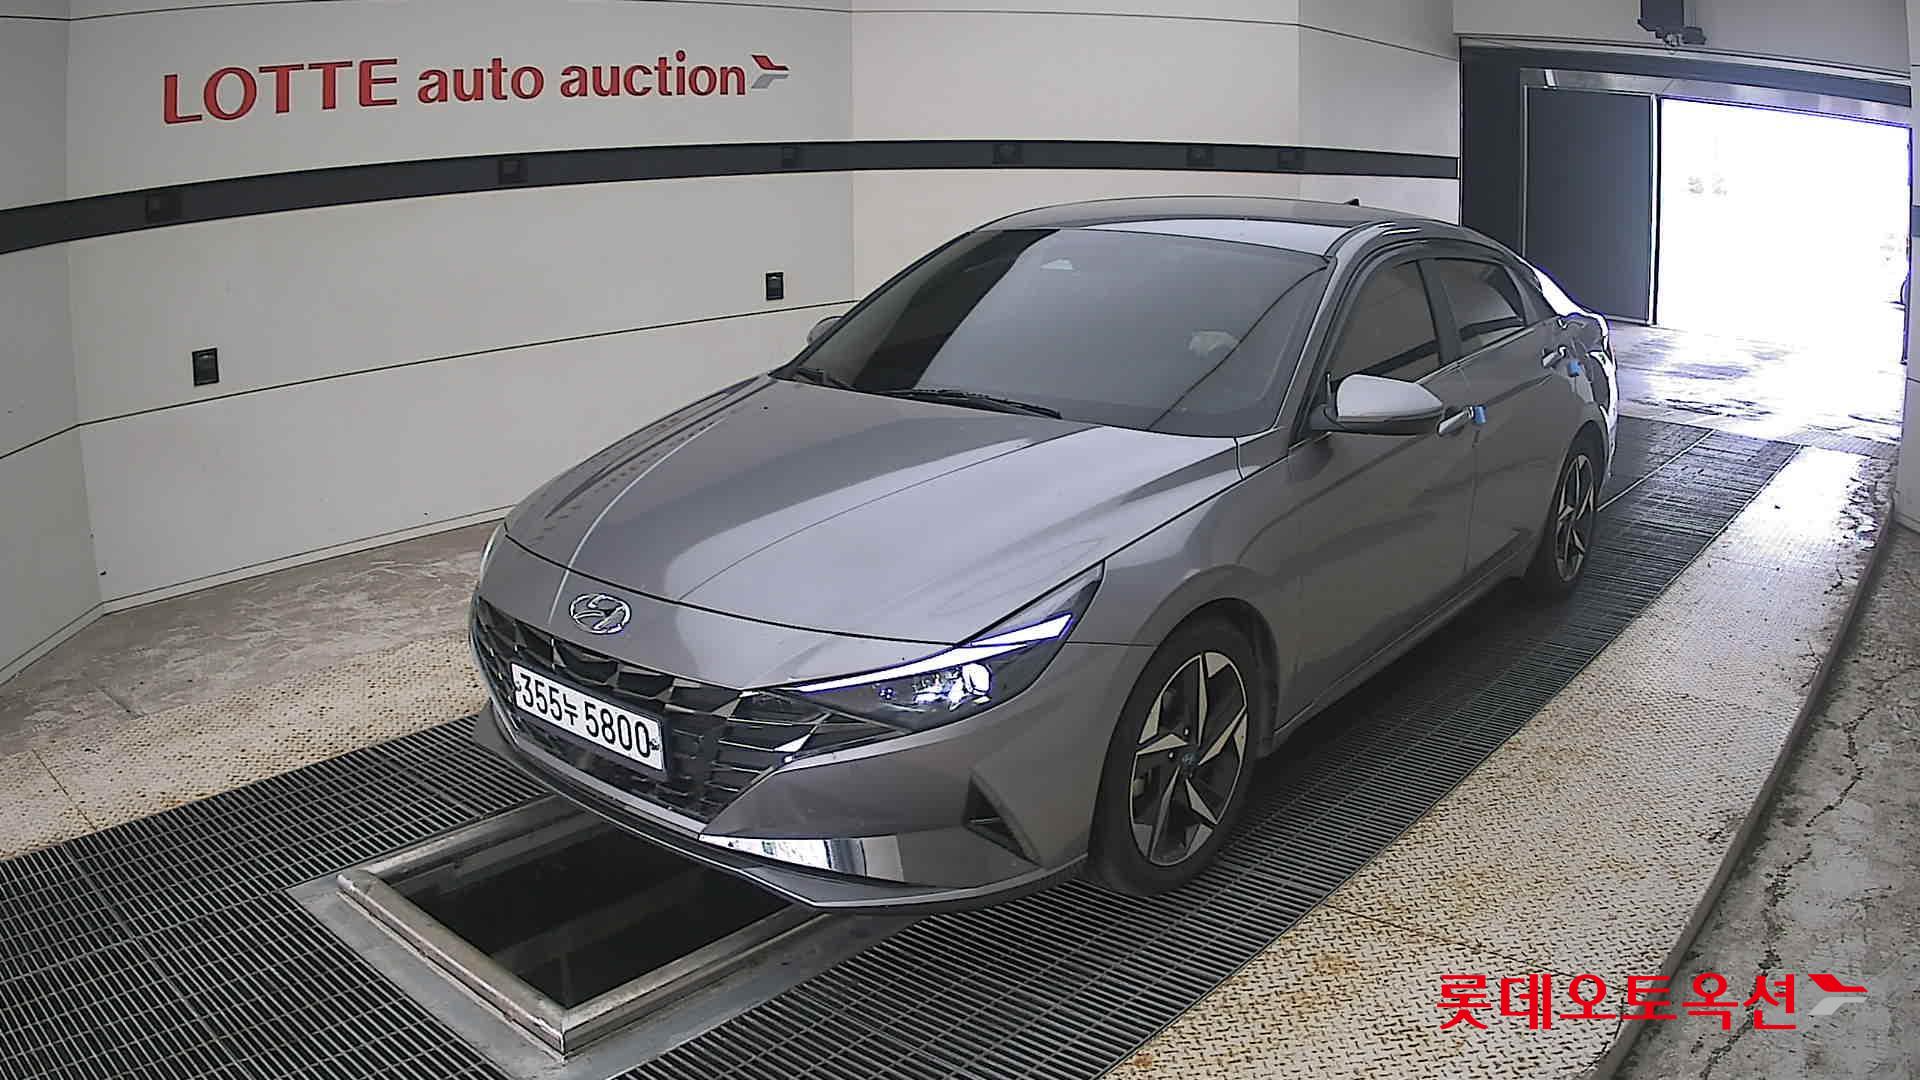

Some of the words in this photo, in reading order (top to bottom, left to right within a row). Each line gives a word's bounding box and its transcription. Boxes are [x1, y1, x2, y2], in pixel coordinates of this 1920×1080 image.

[162, 57, 399, 125] LOTTE
[416, 56, 545, 104] auto
[559, 49, 747, 98] auction
[519, 673, 578, 726] 355누
[584, 700, 651, 758] 5800
